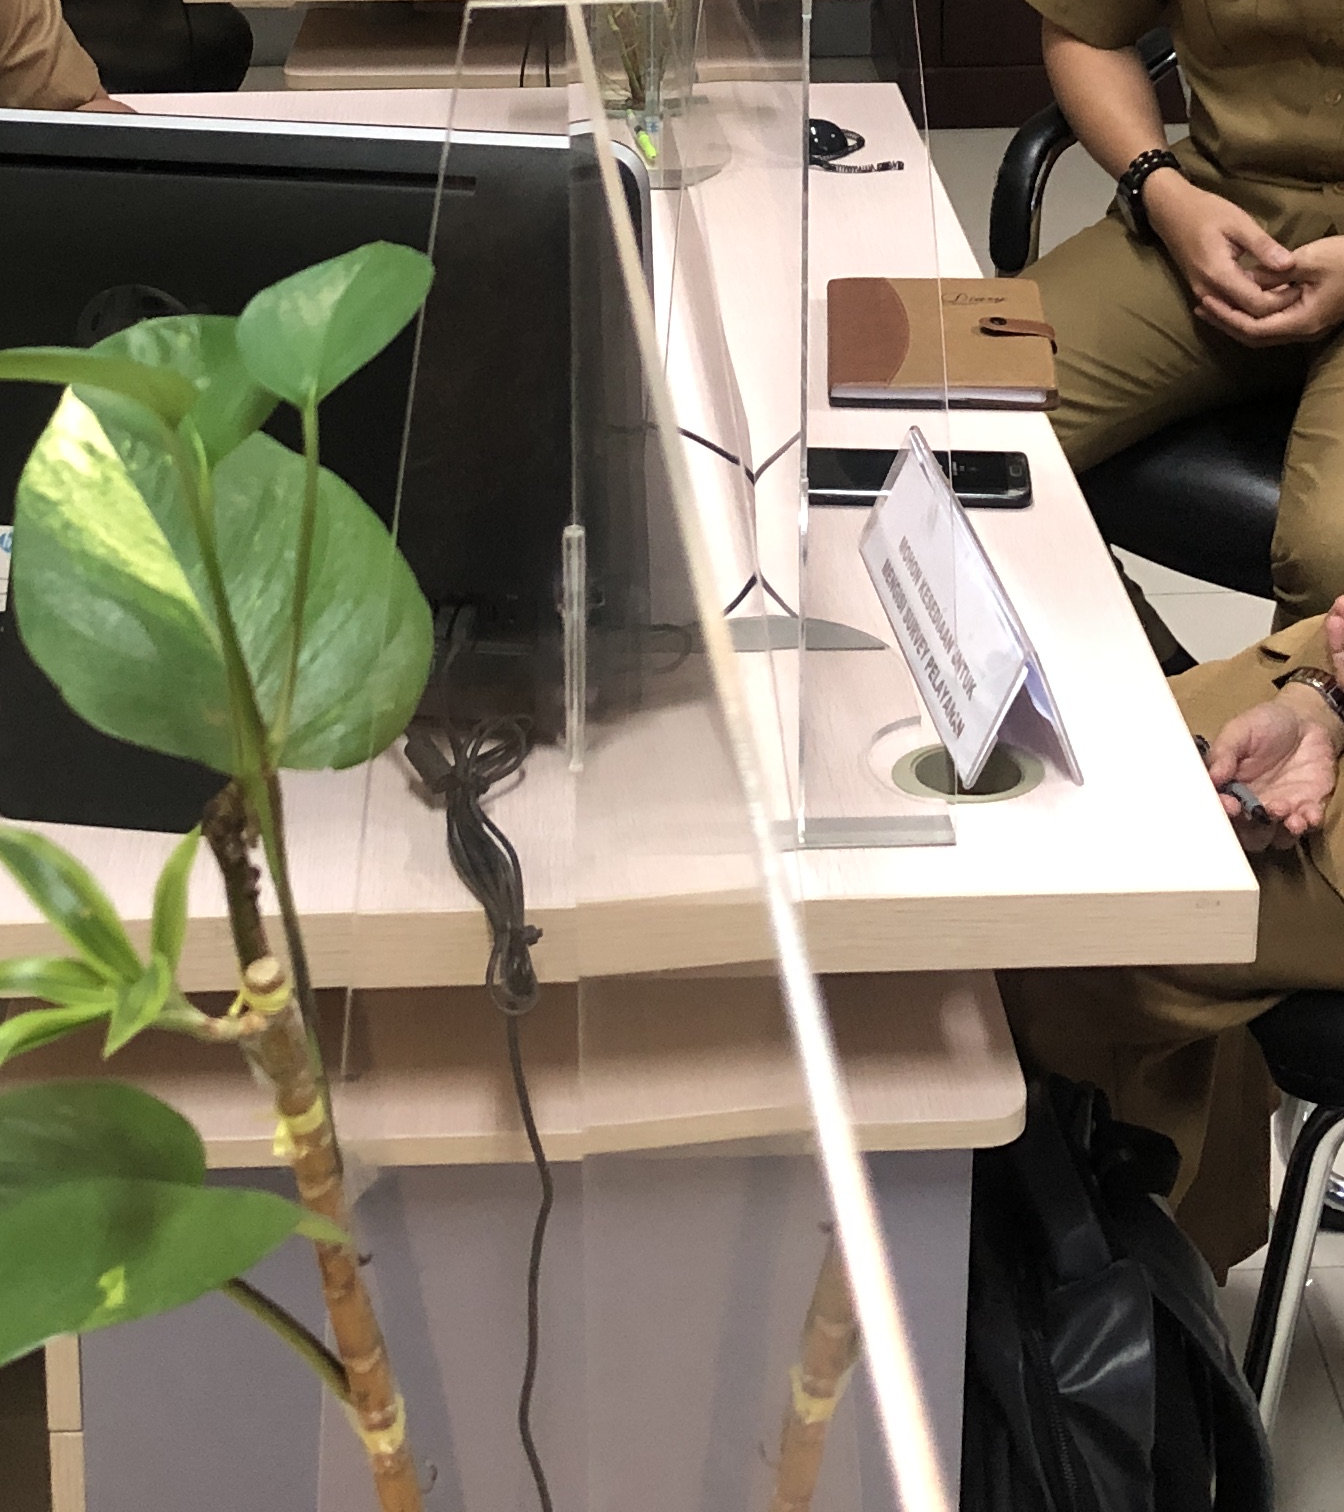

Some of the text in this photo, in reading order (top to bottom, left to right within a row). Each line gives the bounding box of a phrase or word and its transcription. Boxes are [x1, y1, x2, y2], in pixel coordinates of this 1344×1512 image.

[881, 558, 966, 739] MENGISI SURVEY PELAYANAN
[899, 535, 977, 701] MOHON KESEDIAAN UNTUK
